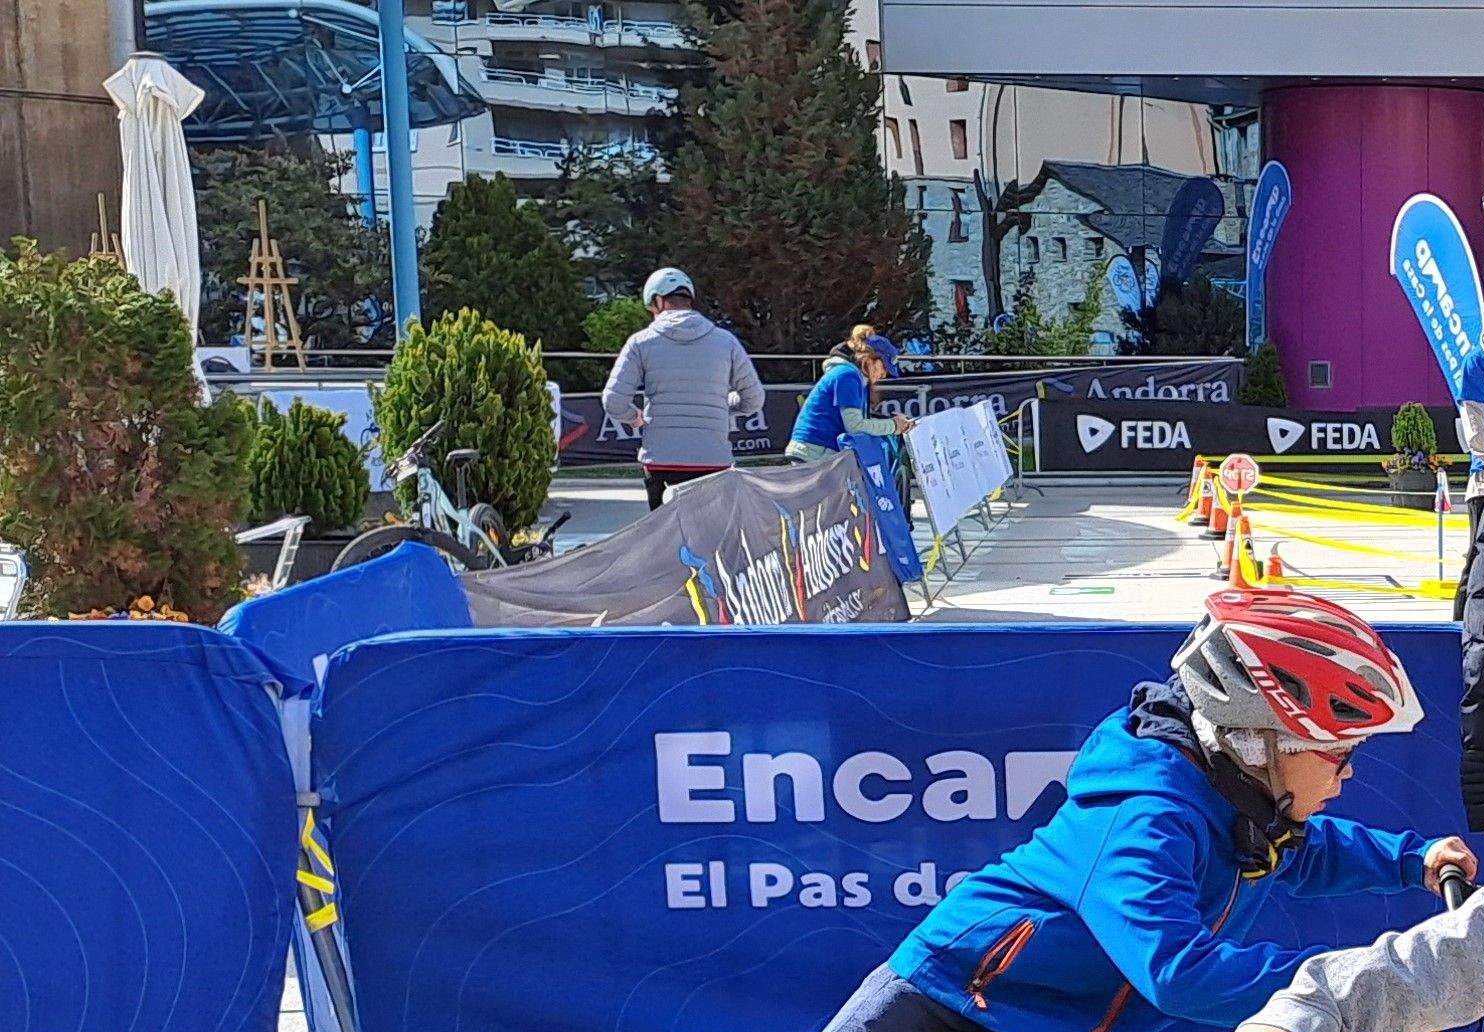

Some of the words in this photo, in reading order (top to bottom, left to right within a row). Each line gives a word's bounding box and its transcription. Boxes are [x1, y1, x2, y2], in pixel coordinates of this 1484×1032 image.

[1086, 376, 1230, 403] Andorra
[1120, 420, 1192, 450] FEDA
[1310, 422, 1381, 451] FEDA
[653, 730, 1078, 824] Enca
[664, 860, 728, 910] El
[748, 861, 873, 909] Pas
